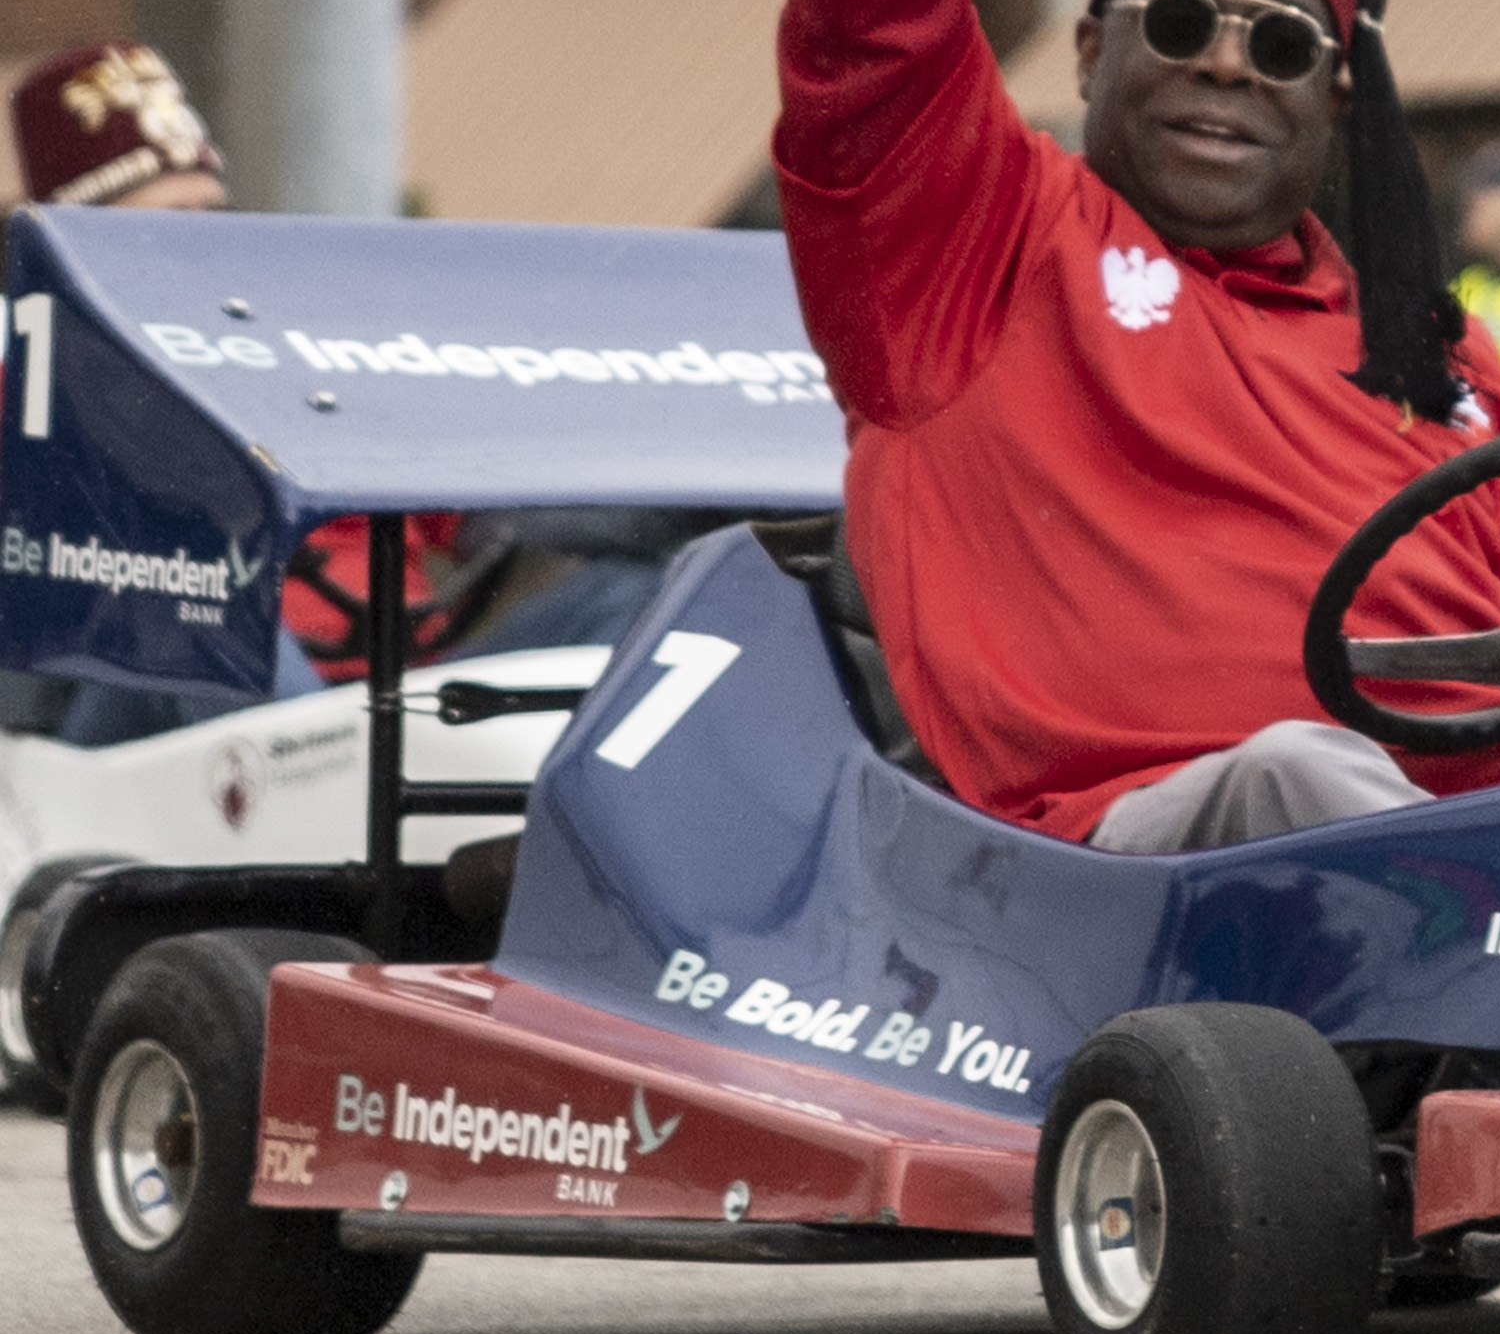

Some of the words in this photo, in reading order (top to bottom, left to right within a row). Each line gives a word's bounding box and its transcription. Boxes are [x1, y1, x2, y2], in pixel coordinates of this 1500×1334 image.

[14, 292, 52, 440] 1
[141, 322, 278, 368] Be
[284, 330, 827, 386] Independen
[3, 526, 44, 575] Be
[49, 533, 230, 601] Independent
[177, 600, 225, 629] BANK
[594, 630, 743, 770] 1
[656, 948, 731, 1010] Be
[724, 977, 871, 1054] Bold.
[863, 1011, 932, 1067] Be
[937, 1020, 1031, 1095] You.
[334, 1073, 386, 1137] Be
[393, 1081, 632, 1174] Independent
[260, 1138, 318, 1186] FDIC
[556, 1173, 619, 1208] BANK
